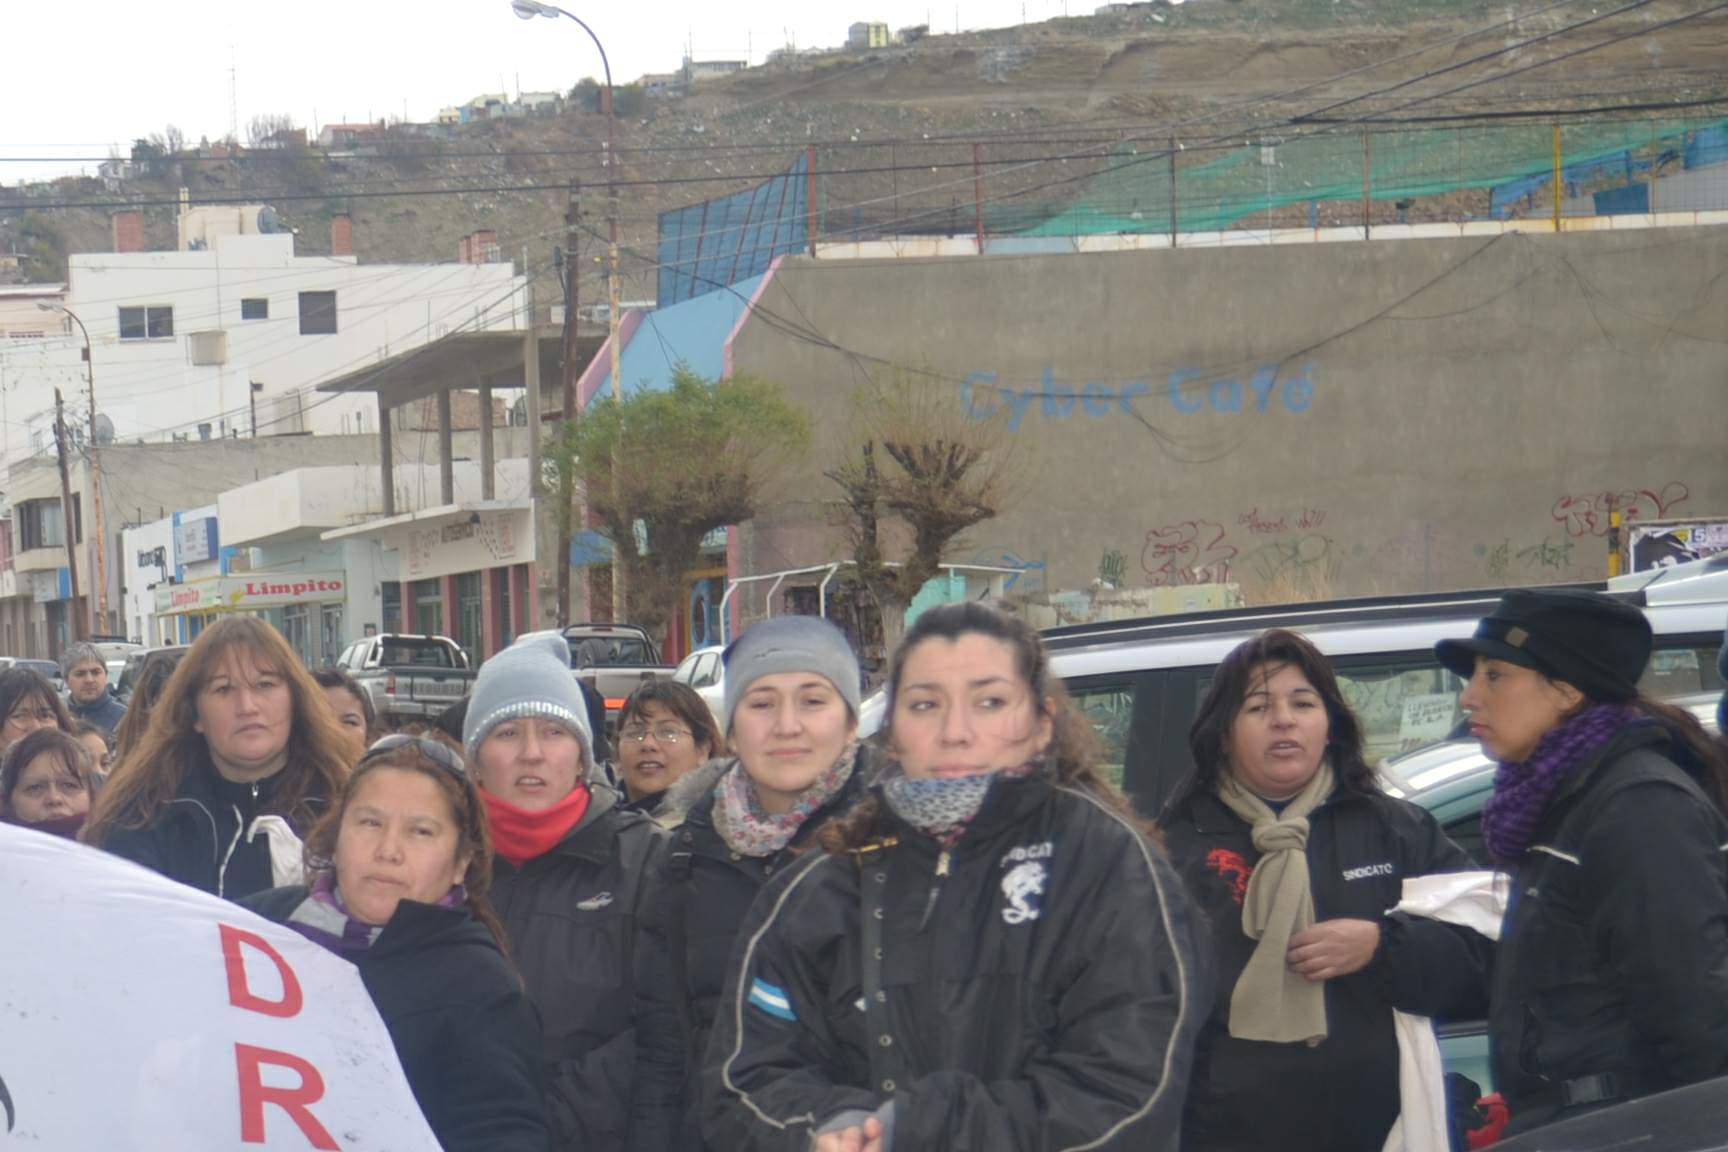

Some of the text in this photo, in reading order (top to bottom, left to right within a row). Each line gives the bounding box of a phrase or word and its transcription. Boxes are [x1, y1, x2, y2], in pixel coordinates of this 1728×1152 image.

[959, 362, 1318, 432] Cyber Café
[1694, 528, 1706, 543] 5
[245, 579, 343, 596] Limpito
